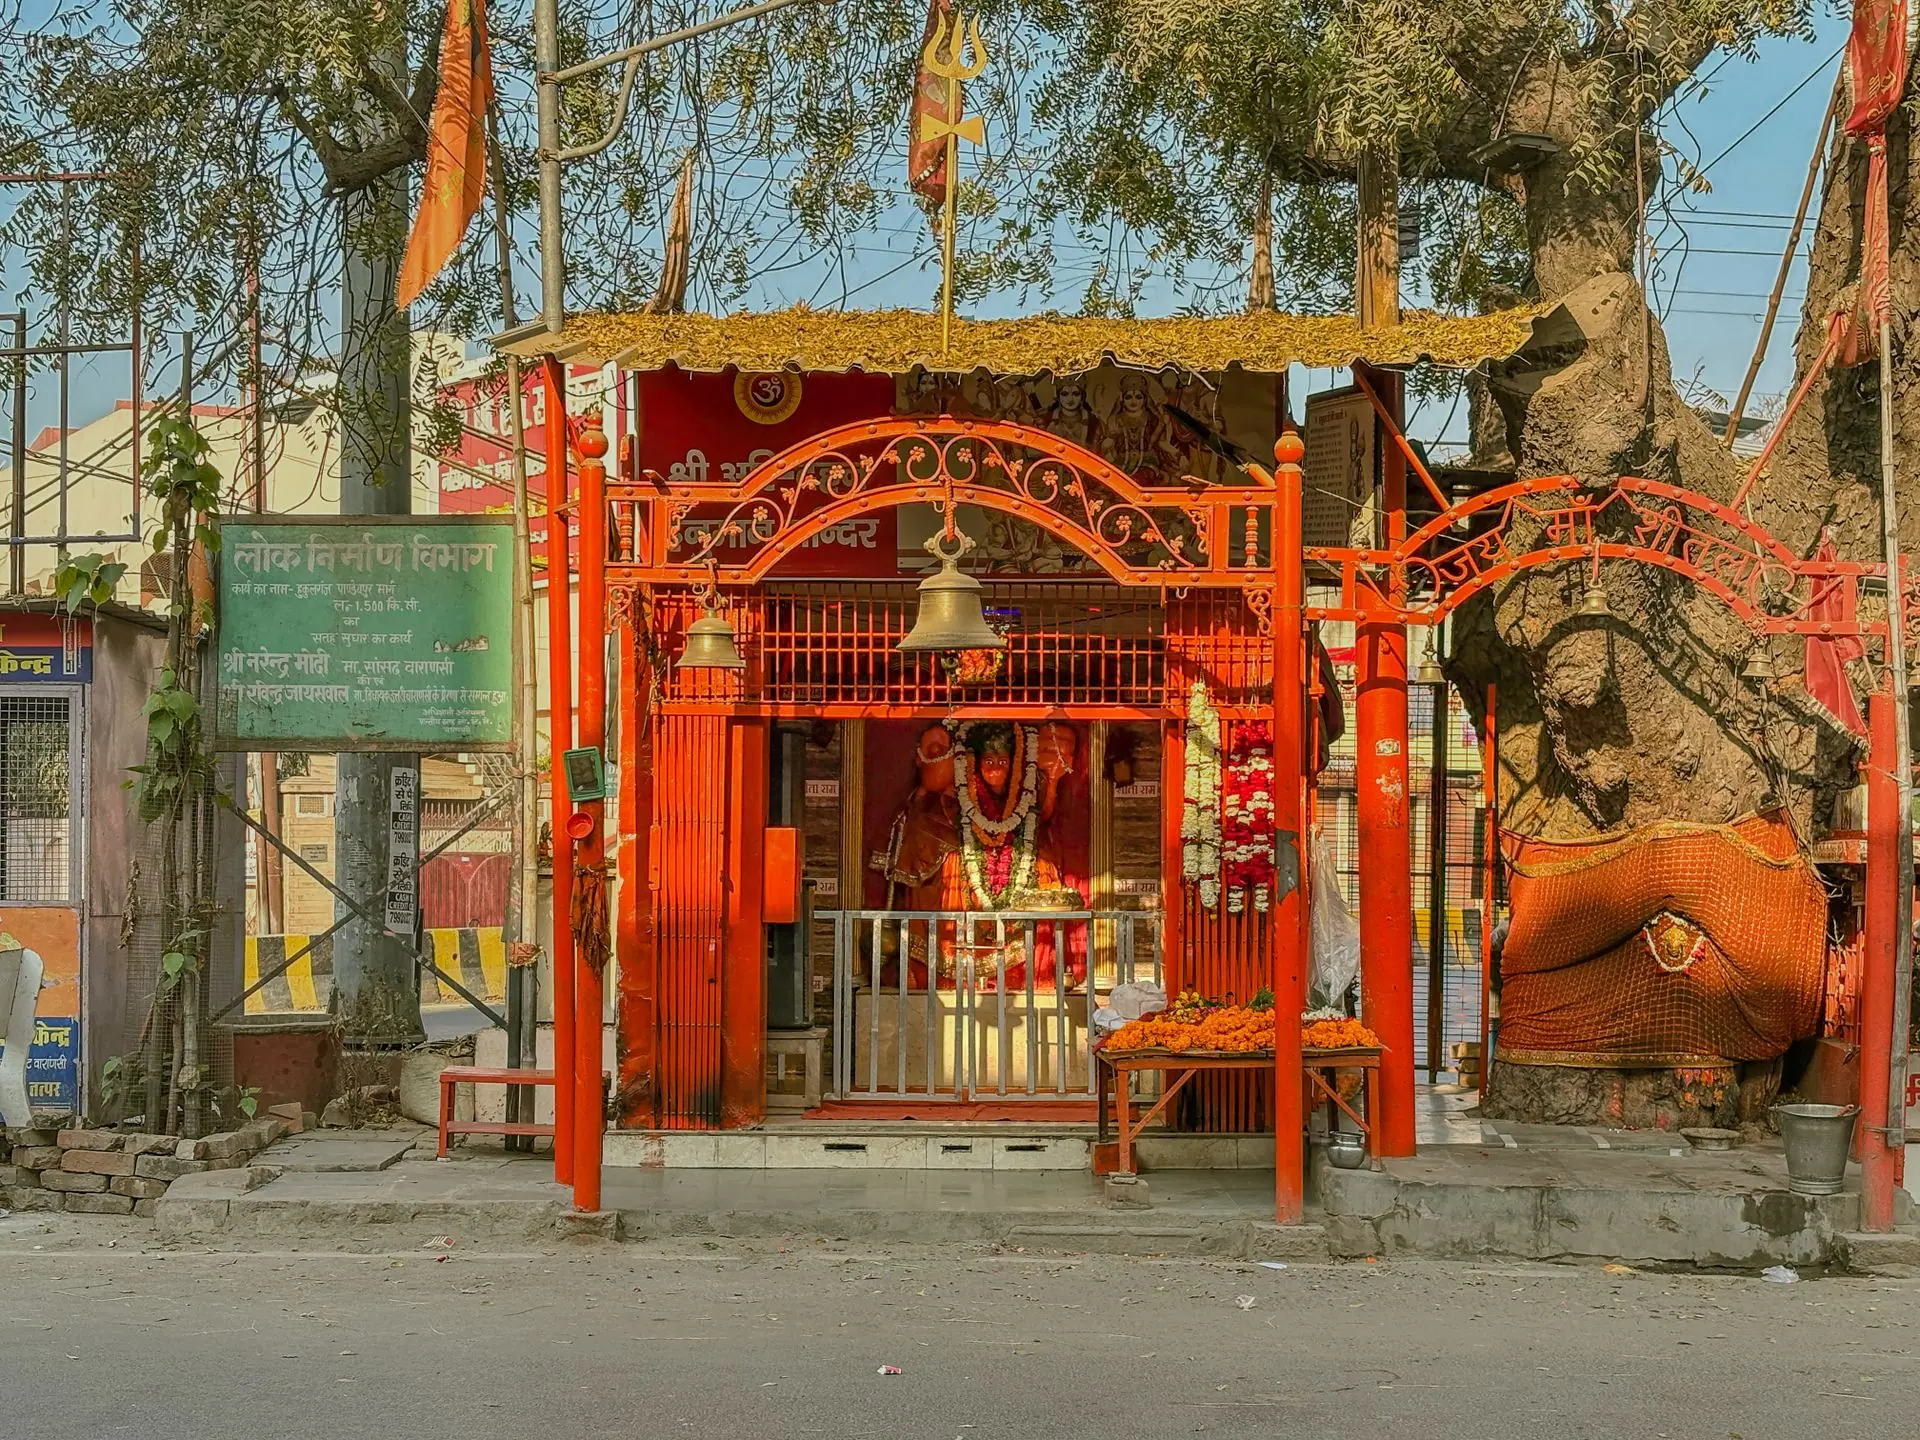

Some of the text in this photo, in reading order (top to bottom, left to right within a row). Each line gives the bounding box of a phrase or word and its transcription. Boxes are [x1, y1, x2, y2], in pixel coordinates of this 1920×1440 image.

[233, 530, 498, 577] लोक निर्माण विभाग
[1432, 527, 1512, 581] जय
[231, 579, 251, 595] कार्य
[253, 583, 269, 595] का
[342, 616, 360, 627] का
[371, 633, 388, 645] का
[389, 629, 414, 645] कार्य
[223, 646, 246, 674] श्री
[247, 645, 292, 679] नरेन्द्र
[293, 647, 331, 678] मोदी
[403, 656, 455, 676] वाराणसी
